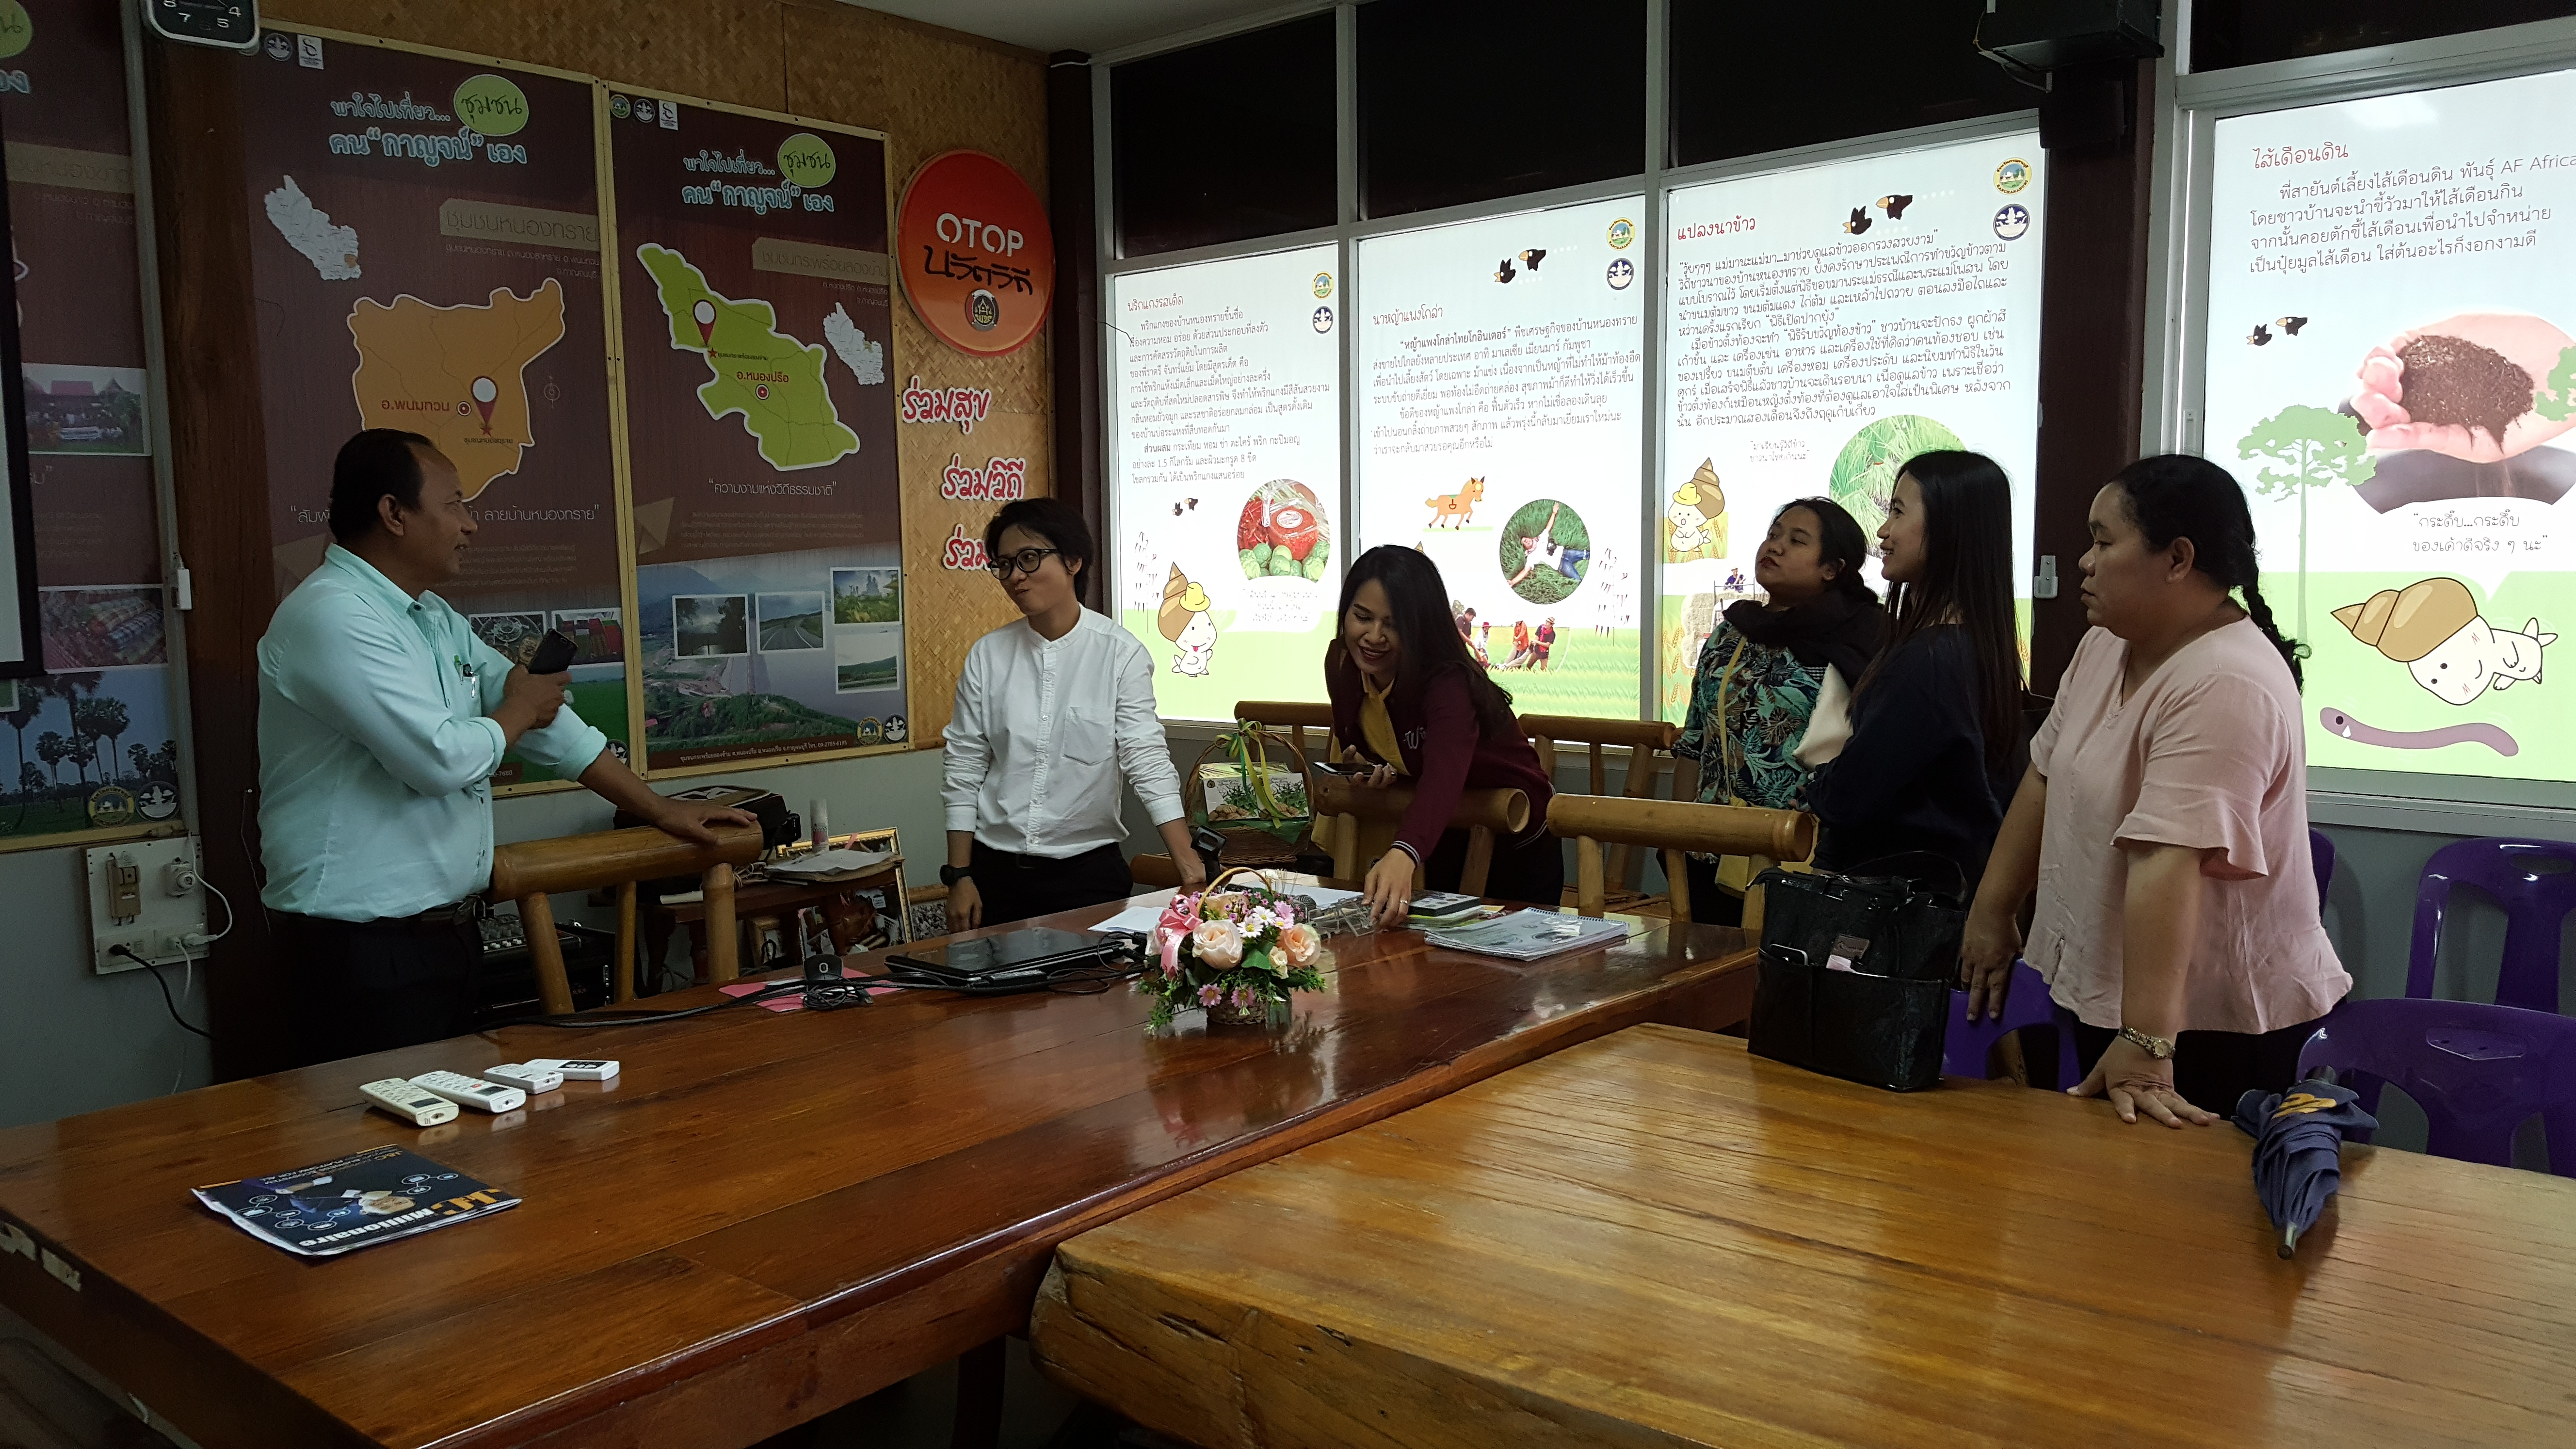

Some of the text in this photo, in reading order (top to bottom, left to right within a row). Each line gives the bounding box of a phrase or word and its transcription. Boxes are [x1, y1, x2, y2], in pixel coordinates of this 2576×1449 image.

[178, 12, 191, 23] 7
[217, 18, 229, 28] 5
[228, 7, 241, 17] 4
[461, 96, 523, 123] ชุมชน
[783, 150, 831, 177] ชุมชน
[2253, 142, 2348, 168] ไส้เดือนดิน
[2280, 166, 2453, 199] พี่สายันต์เลี้ยงไส้เดือนดิน
[2461, 158, 2495, 181] พันธุ์
[2501, 159, 2523, 174] AF
[2251, 183, 2523, 226] โดยชาวบ้านจะนำขี้วัวมาให้ไส้เดือนกิน
[936, 213, 1024, 257] OTOP
[1678, 215, 1755, 240] แปลงนาข้าว
[2251, 205, 2551, 249] จากนั้นคอยตักขี้ไส้เดือนเพื่อนำไปจำหน่าย
[2251, 229, 2536, 274] เป็นปุ๋ยมูลไส้เดือน ใส่ต้นอะไรก็งอกงามดี
[1988, 257, 2009, 271] โดย
[1127, 292, 1183, 311] พริกแกงรสเด็ด
[1743, 300, 1795, 314] ขนมต้มแดง
[1800, 294, 1825, 308] ไก่ต้ม
[1830, 286, 1913, 305] และเหล้าไปถวาย
[1918, 275, 2007, 296] ตอนลงมือไถและ
[1373, 304, 1443, 326] นาหญ้าแพงโกล่า
[1968, 308, 2006, 329] ผูกผ้าสี
[1174, 332, 1191, 342] อร่อย
[1193, 320, 1269, 340] ด้วยส่วนประกอบที่ลงตัว
[1514, 315, 1637, 338] พืชเศรษฐกิจของบ้านหนองทราย
[1474, 347, 1489, 360] อาทิ
[1526, 339, 1560, 354] เมียนมาร์
[1563, 338, 1591, 354] กัมพูชา
[1678, 351, 1707, 367] เก้าชั้น
[1711, 355, 1729, 363] และ
[1785, 346, 1816, 357] อาหาร
[1984, 326, 2004, 340] เช่น
[1240, 356, 1249, 367] คือ
[1435, 369, 1471, 381] โดยเฉพาะ
[1474, 364, 1497, 378] ม้าแข่ง
[1677, 385, 1697, 399] ศุกร์
[1964, 379, 2011, 393] หลังจาก
[381, 400, 451, 412] อ.พนมทวน
[903, 376, 991, 434] ร่วมสุข
[1479, 402, 1489, 413] คือ
[1472, 419, 1498, 431] สักภาพ
[1677, 413, 1691, 427] นั้น
[1144, 443, 1171, 453] ส่วนผสม
[1173, 440, 1201, 451] กระเทียม
[1231, 435, 1250, 447] ตะไคร้
[1253, 436, 1267, 446] พริก
[1132, 459, 1155, 469] อย่างละ
[1158, 459, 1167, 467] 1.5
[1170, 456, 1193, 466] กิโลกรัม
[1195, 454, 1238, 467] และผิวมะกรูด
[1241, 454, 1245, 463] 8
[943, 455, 1025, 499] ร่วมวิถี
[2413, 536, 2500, 552] ของเค้าดีจริง
[298, 1207, 435, 1248] Millionaire
